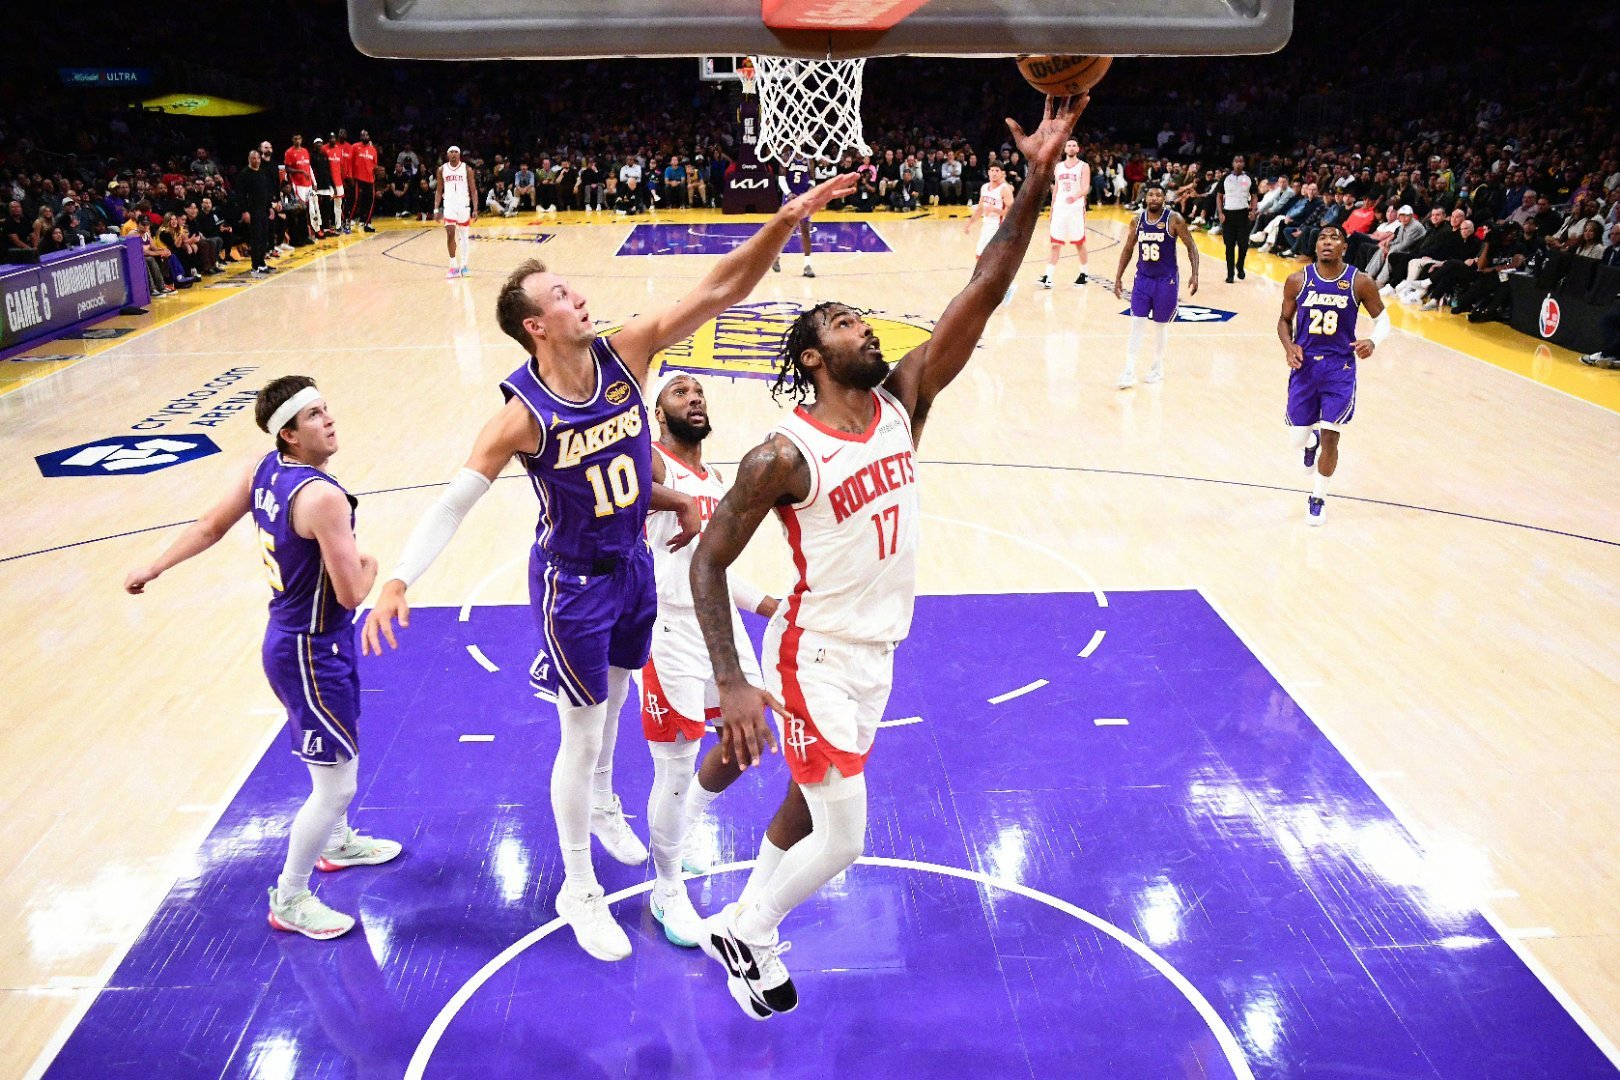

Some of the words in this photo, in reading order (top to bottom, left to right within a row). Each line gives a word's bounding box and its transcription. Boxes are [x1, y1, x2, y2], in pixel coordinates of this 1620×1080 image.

[106, 71, 138, 82] ULTRA
[793, 171, 802, 184] 5
[1141, 242, 1161, 262] 36
[51, 260, 97, 298] TOMORROW
[5, 285, 43, 332] GAME
[41, 282, 52, 320] 6
[77, 291, 107, 319] peacock
[1302, 290, 1350, 309] LAKERS
[1308, 308, 1339, 336] 28
[189, 389, 259, 428] ARENA
[553, 404, 643, 470] LAKERS
[585, 453, 640, 518] 10
[828, 450, 915, 525] ROCKETS
[870, 504, 899, 561] 17
[258, 526, 285, 592] 5
[302, 728, 325, 757] LA
